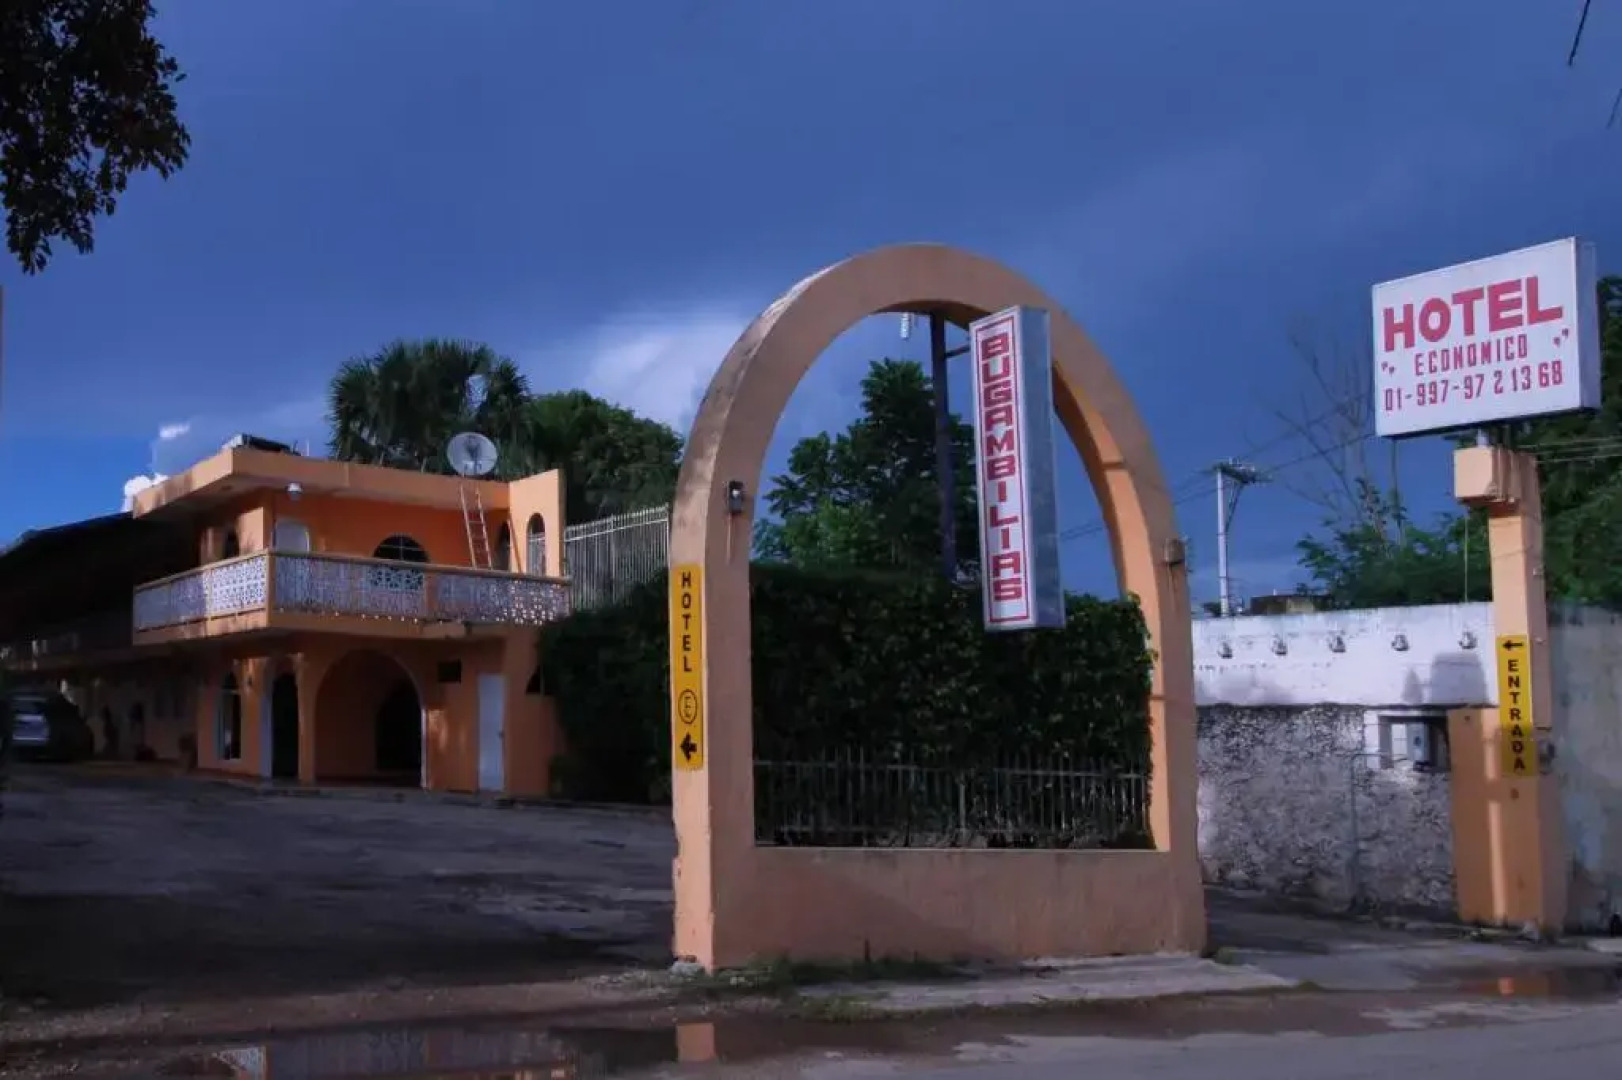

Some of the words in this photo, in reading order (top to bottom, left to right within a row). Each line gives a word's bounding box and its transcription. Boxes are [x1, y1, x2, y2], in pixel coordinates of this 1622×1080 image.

[1383, 276, 1563, 352] HOTEL
[1415, 334, 1528, 376] ECONOMICO
[981, 332, 1022, 601] BUGAMBILIAS
[681, 571, 692, 672] HOTEL
[1508, 659, 1526, 769] ENTRADA
